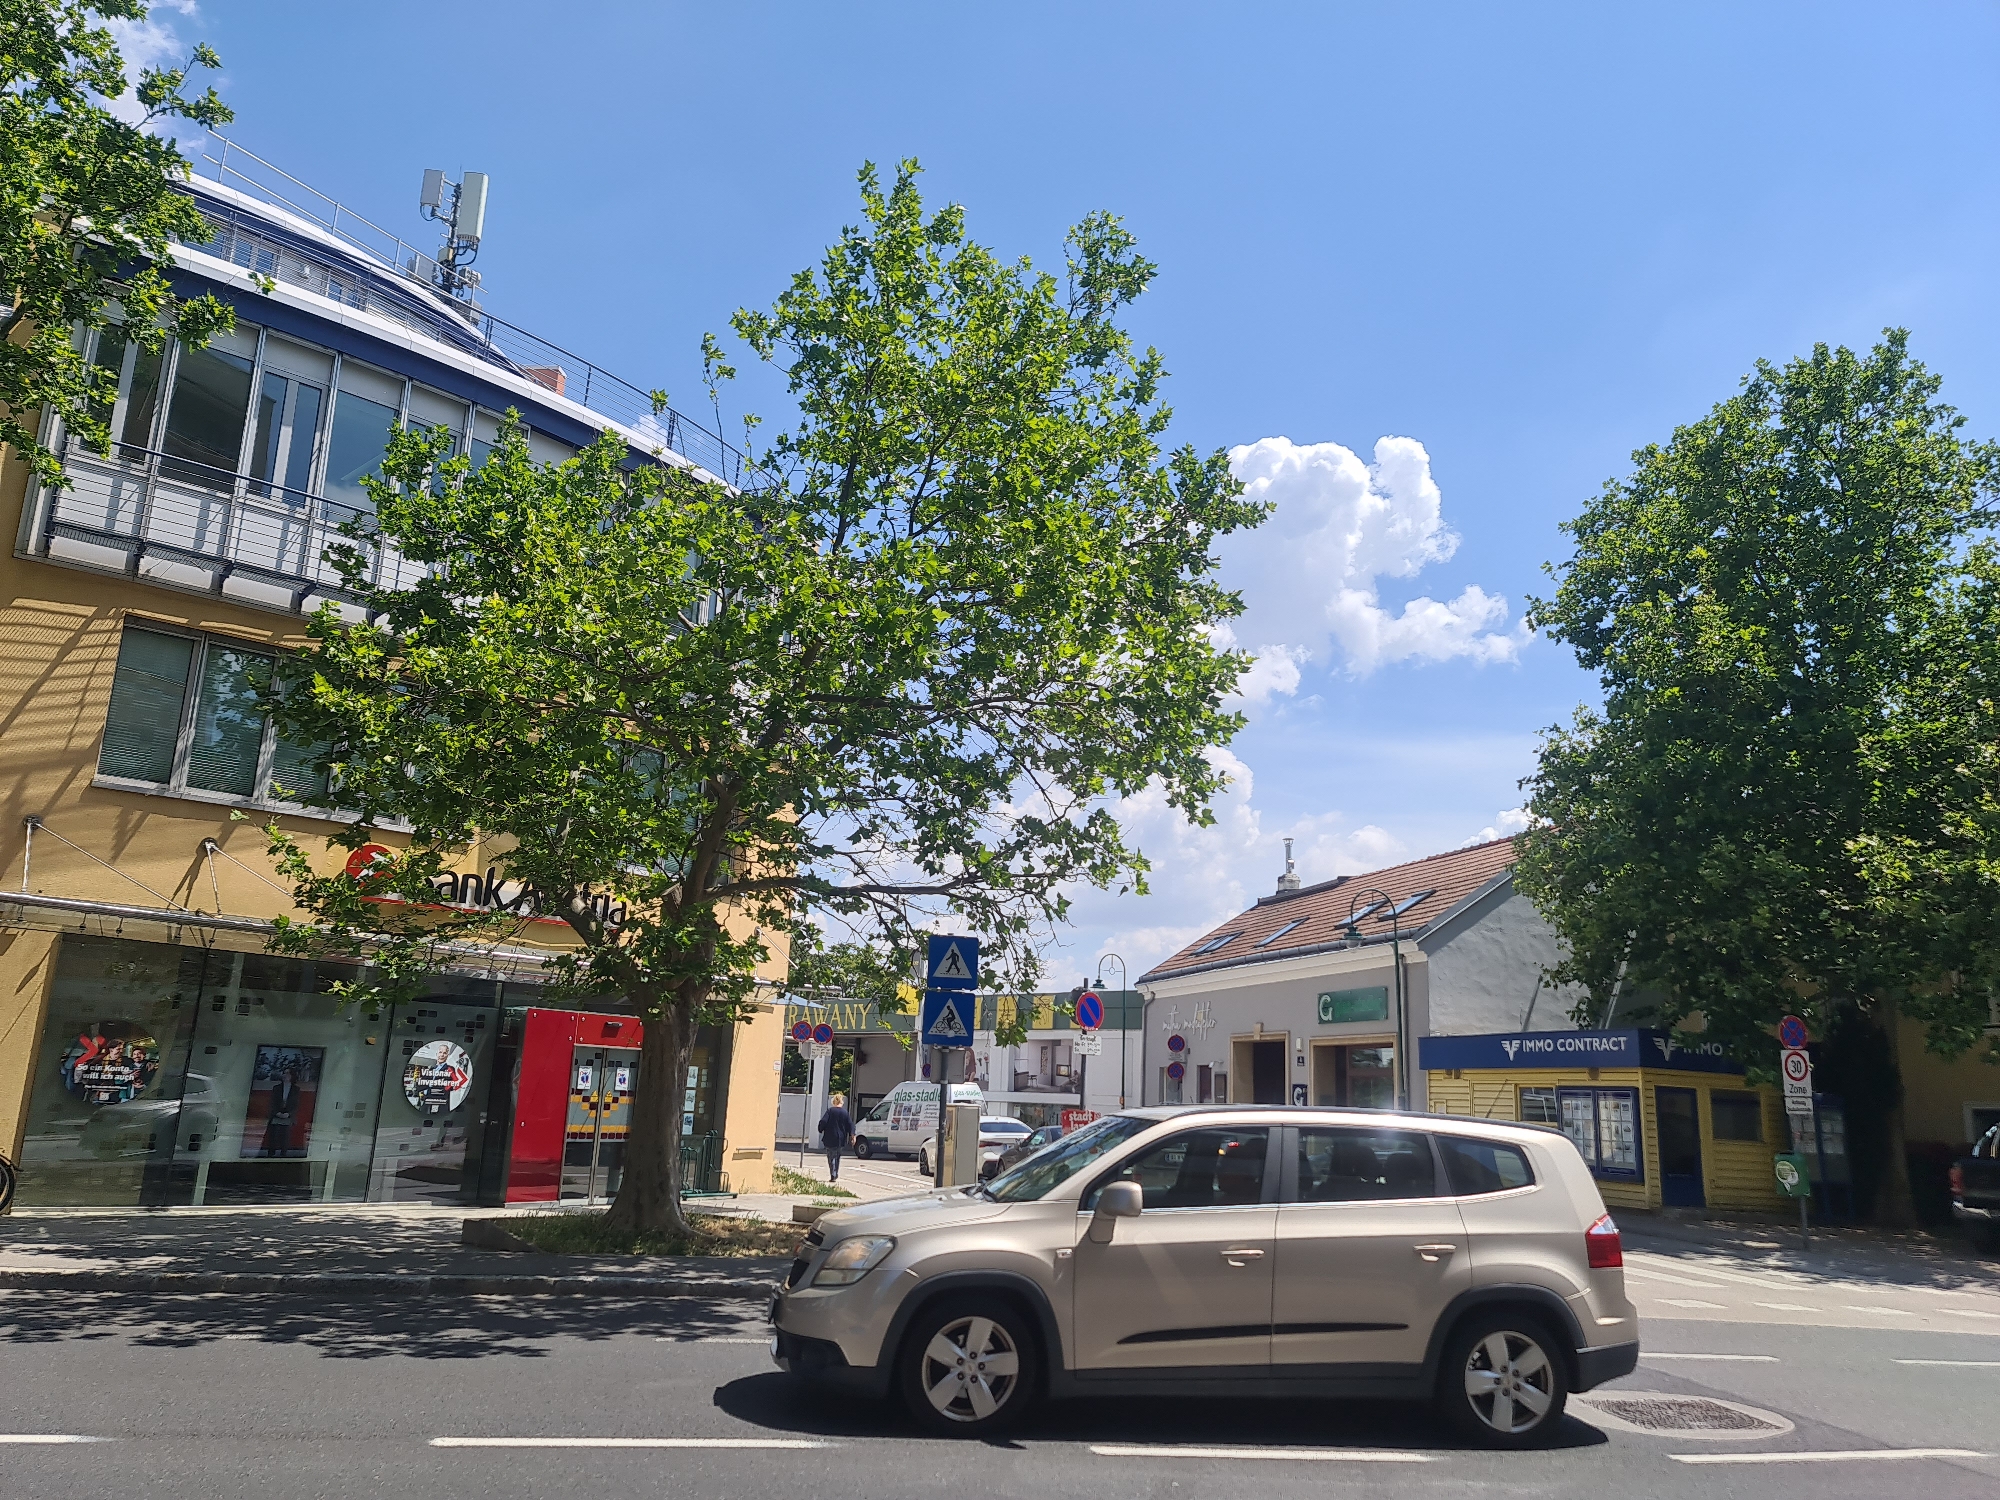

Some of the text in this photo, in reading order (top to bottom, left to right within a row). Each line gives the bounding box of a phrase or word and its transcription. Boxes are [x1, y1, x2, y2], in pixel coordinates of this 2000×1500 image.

[424, 866, 508, 911] ank
[784, 1003, 872, 1031] RAWANY
[1522, 1036, 1627, 1053] IMMO CONTRACT
[77, 1063, 130, 1072] So ein Konto
[421, 1068, 452, 1077] Visionär
[1790, 1060, 1802, 1074] 30
[100, 1072, 113, 1080] ich
[114, 1073, 134, 1081] auch
[1788, 1083, 1807, 1094] Zone
[893, 1087, 941, 1104] glas-stadle
[1068, 1110, 1093, 1121] stadt
